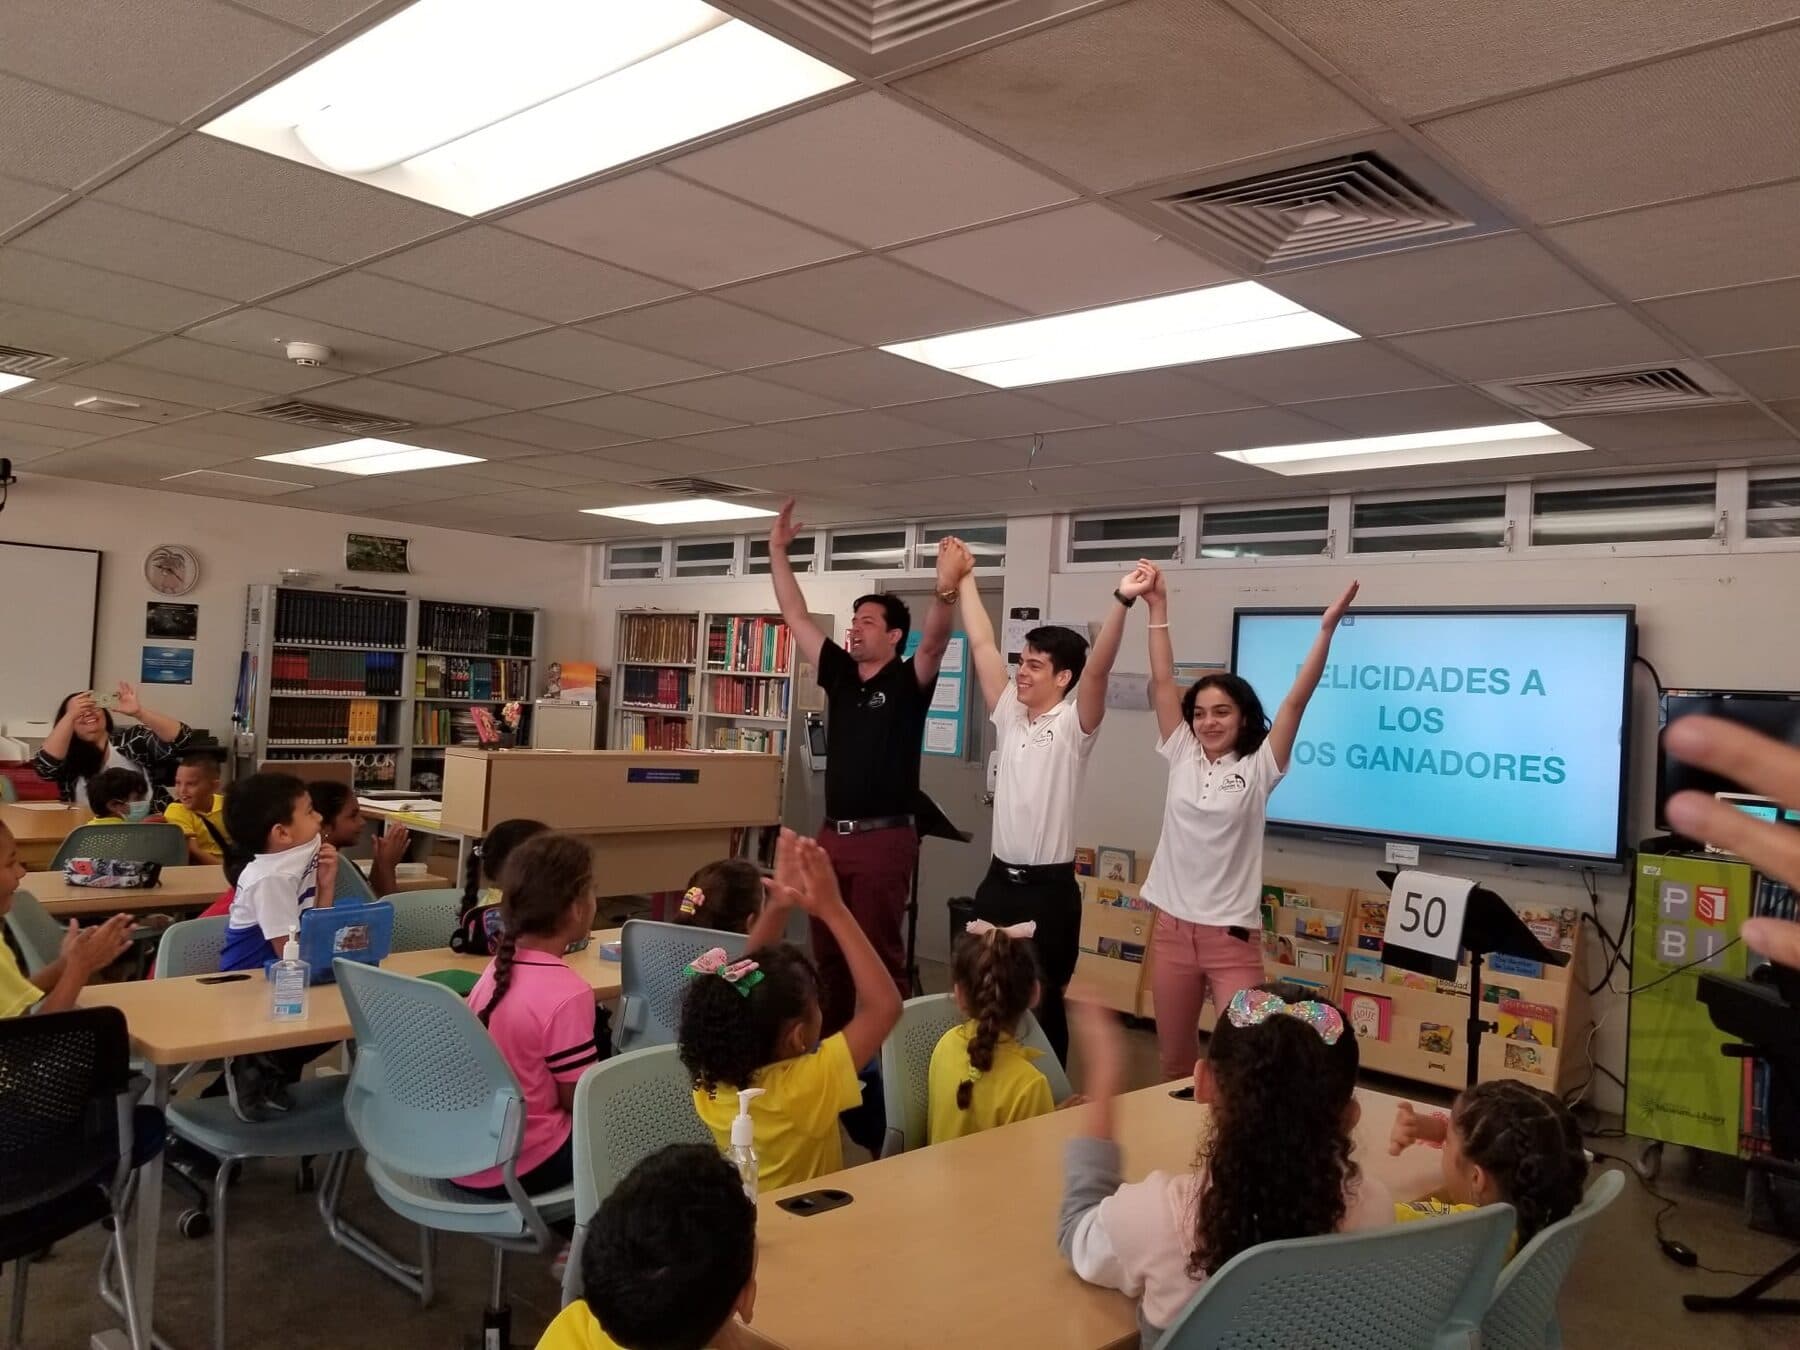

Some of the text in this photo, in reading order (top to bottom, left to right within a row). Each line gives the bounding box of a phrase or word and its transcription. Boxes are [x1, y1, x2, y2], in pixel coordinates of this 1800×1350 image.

[1296, 664, 1547, 696] ELICIDADES A
[1378, 705, 1444, 734] LOS
[353, 752, 395, 768] BOOK
[1294, 741, 1566, 784] OS GANADORES
[1400, 891, 1447, 938] 50
[1664, 887, 1688, 913] P
[1661, 930, 1686, 957] B
